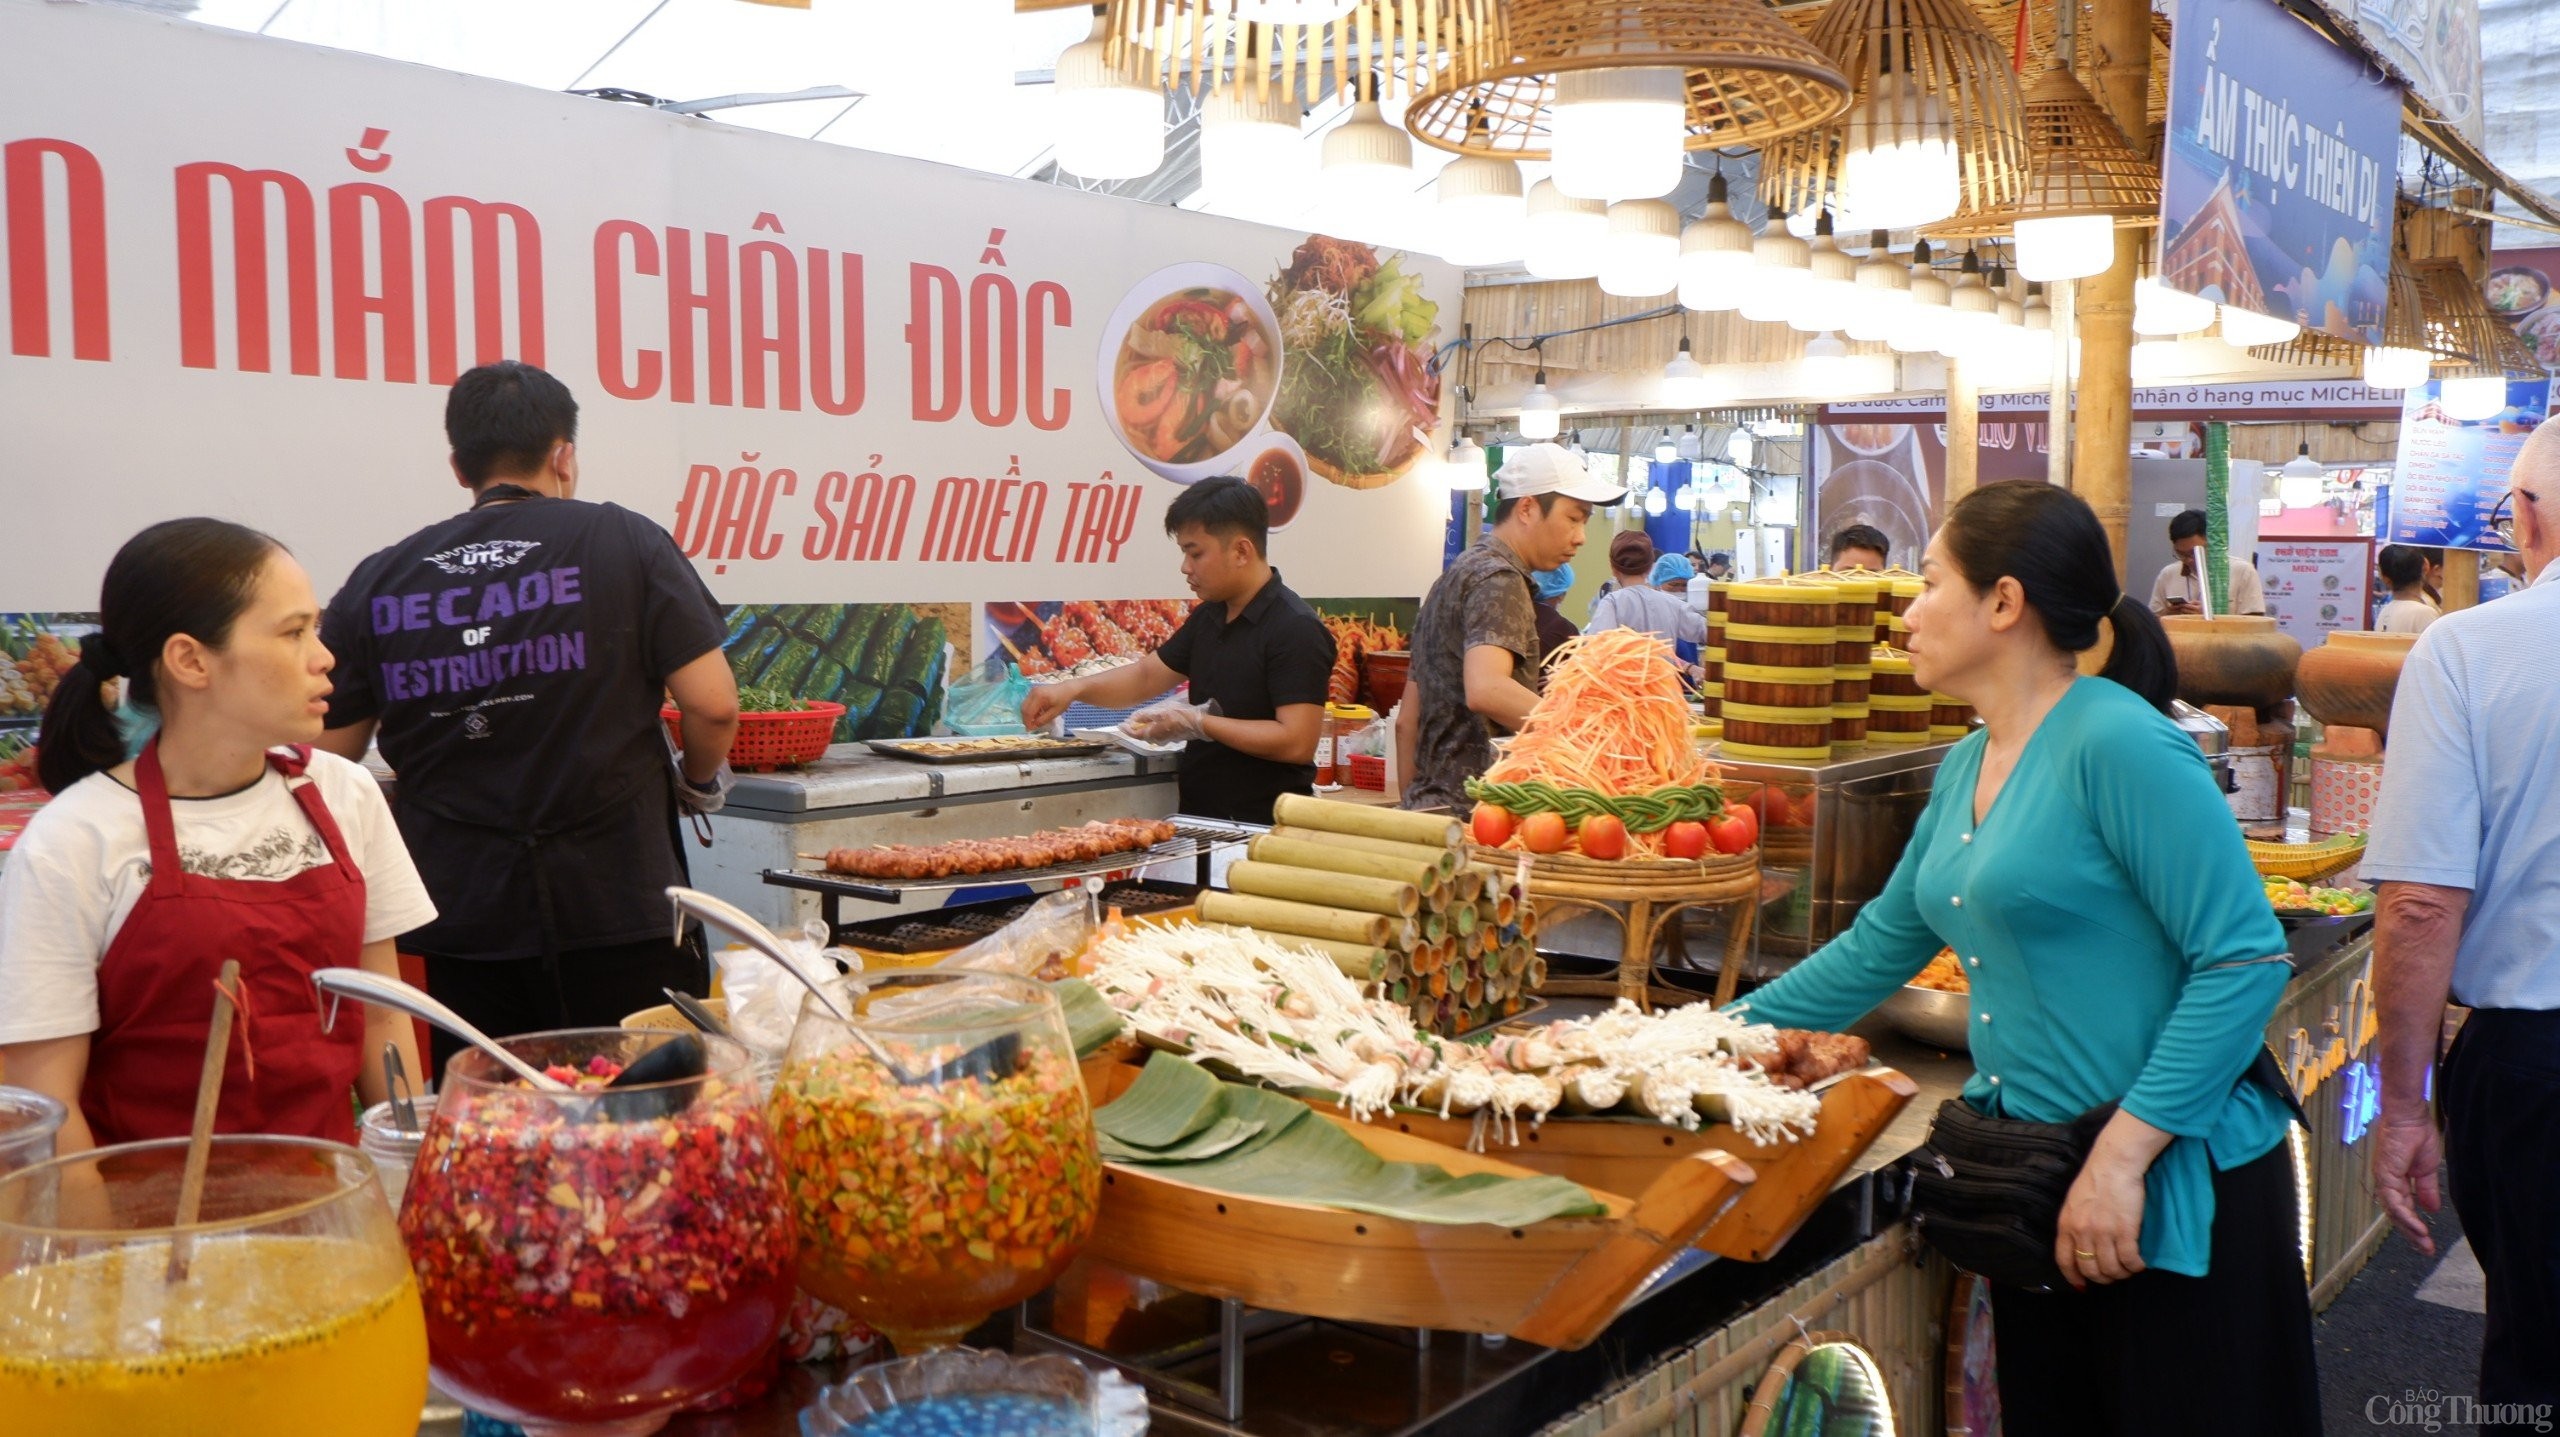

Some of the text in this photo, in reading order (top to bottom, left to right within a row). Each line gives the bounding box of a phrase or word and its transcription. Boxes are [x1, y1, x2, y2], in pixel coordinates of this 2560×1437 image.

[2243, 88, 2300, 205] THỰC
[2305, 121, 2357, 217] THIÊN
[592, 211, 866, 416] CHÂU
[905, 228, 1072, 431] ĐỐC
[2186, 387, 2198, 403] ở
[2204, 387, 2254, 407] hạng
[2261, 390, 2304, 407] mục
[672, 452, 1143, 574] ĐẶC SẢN MIỀN TÂY
[463, 549, 504, 566] UTC
[2292, 565, 2319, 573] MENU
[371, 567, 582, 636] DECADE
[463, 627, 491, 646] OF
